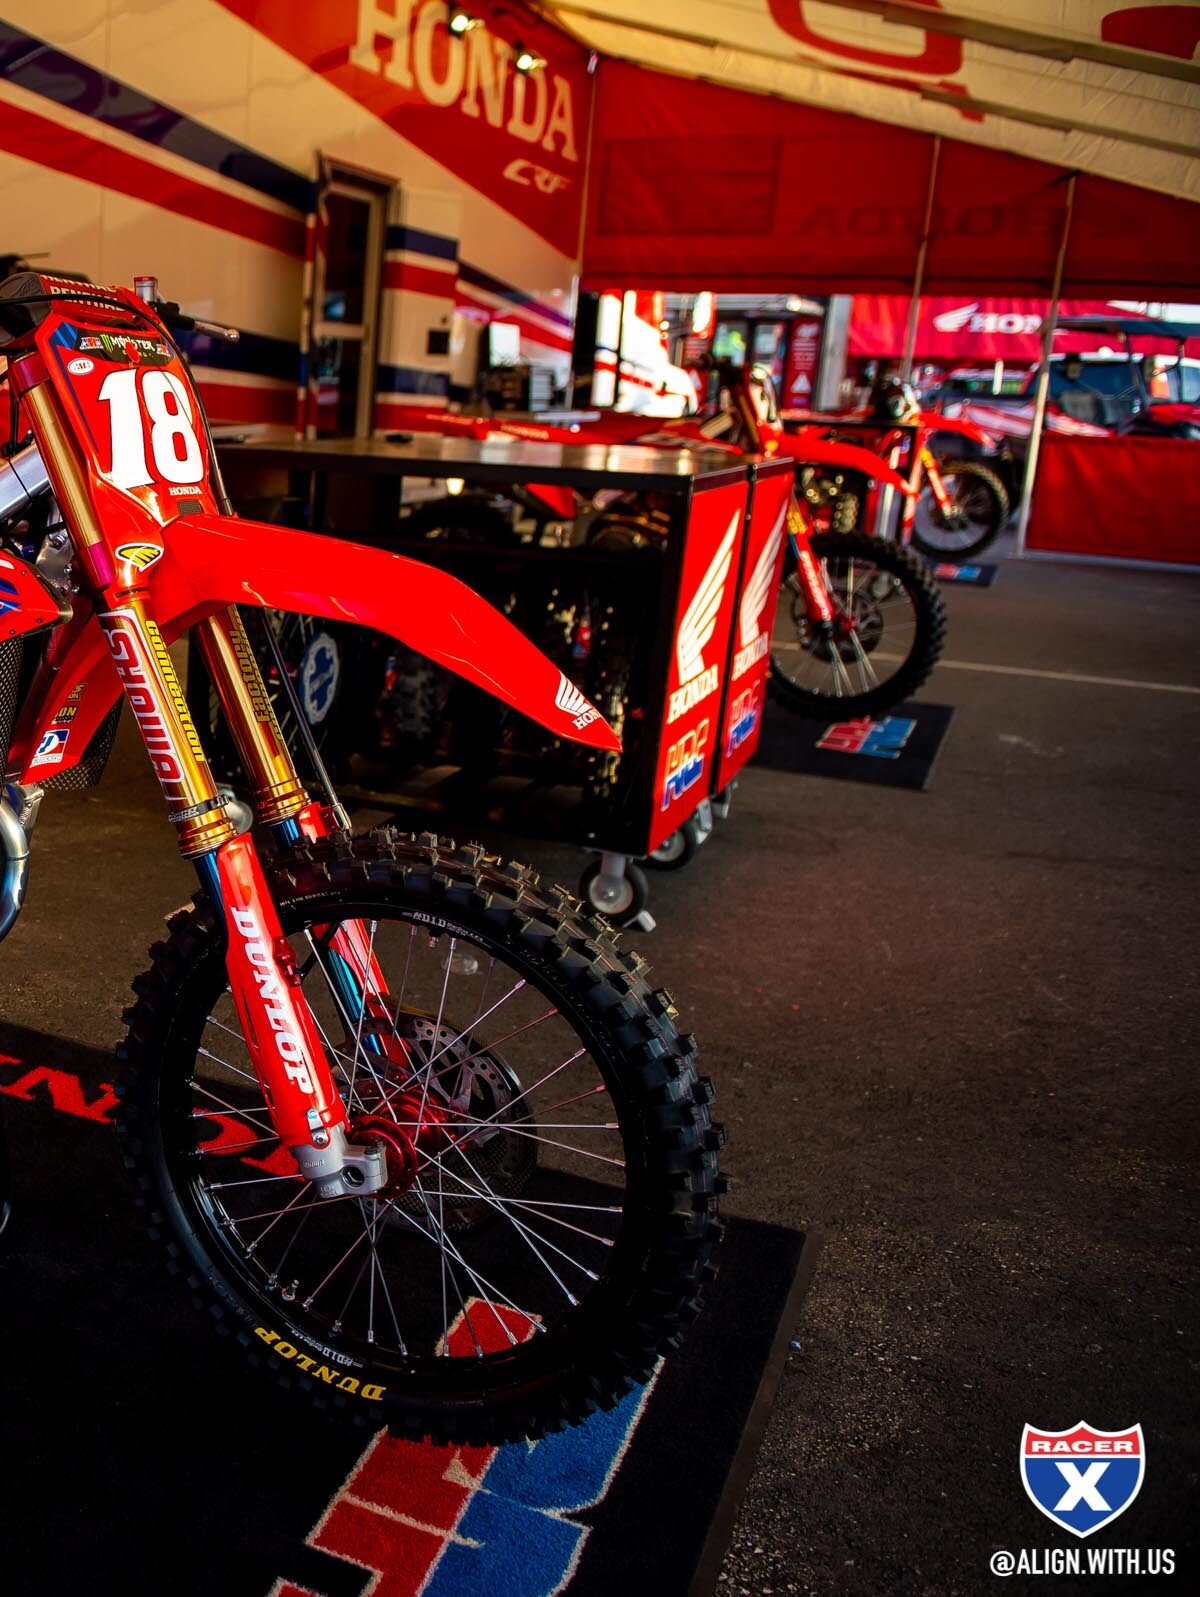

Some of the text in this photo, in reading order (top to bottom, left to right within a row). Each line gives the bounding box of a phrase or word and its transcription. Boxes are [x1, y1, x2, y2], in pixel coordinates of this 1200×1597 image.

[349, 0, 579, 163] HONDA
[98, 368, 205, 485] 18
[168, 486, 203, 496] HONDA
[666, 663, 719, 724] HONDA
[731, 641, 769, 682] HONDA
[231, 905, 315, 1096] DUNLOP
[254, 1326, 388, 1401] DUNLOP
